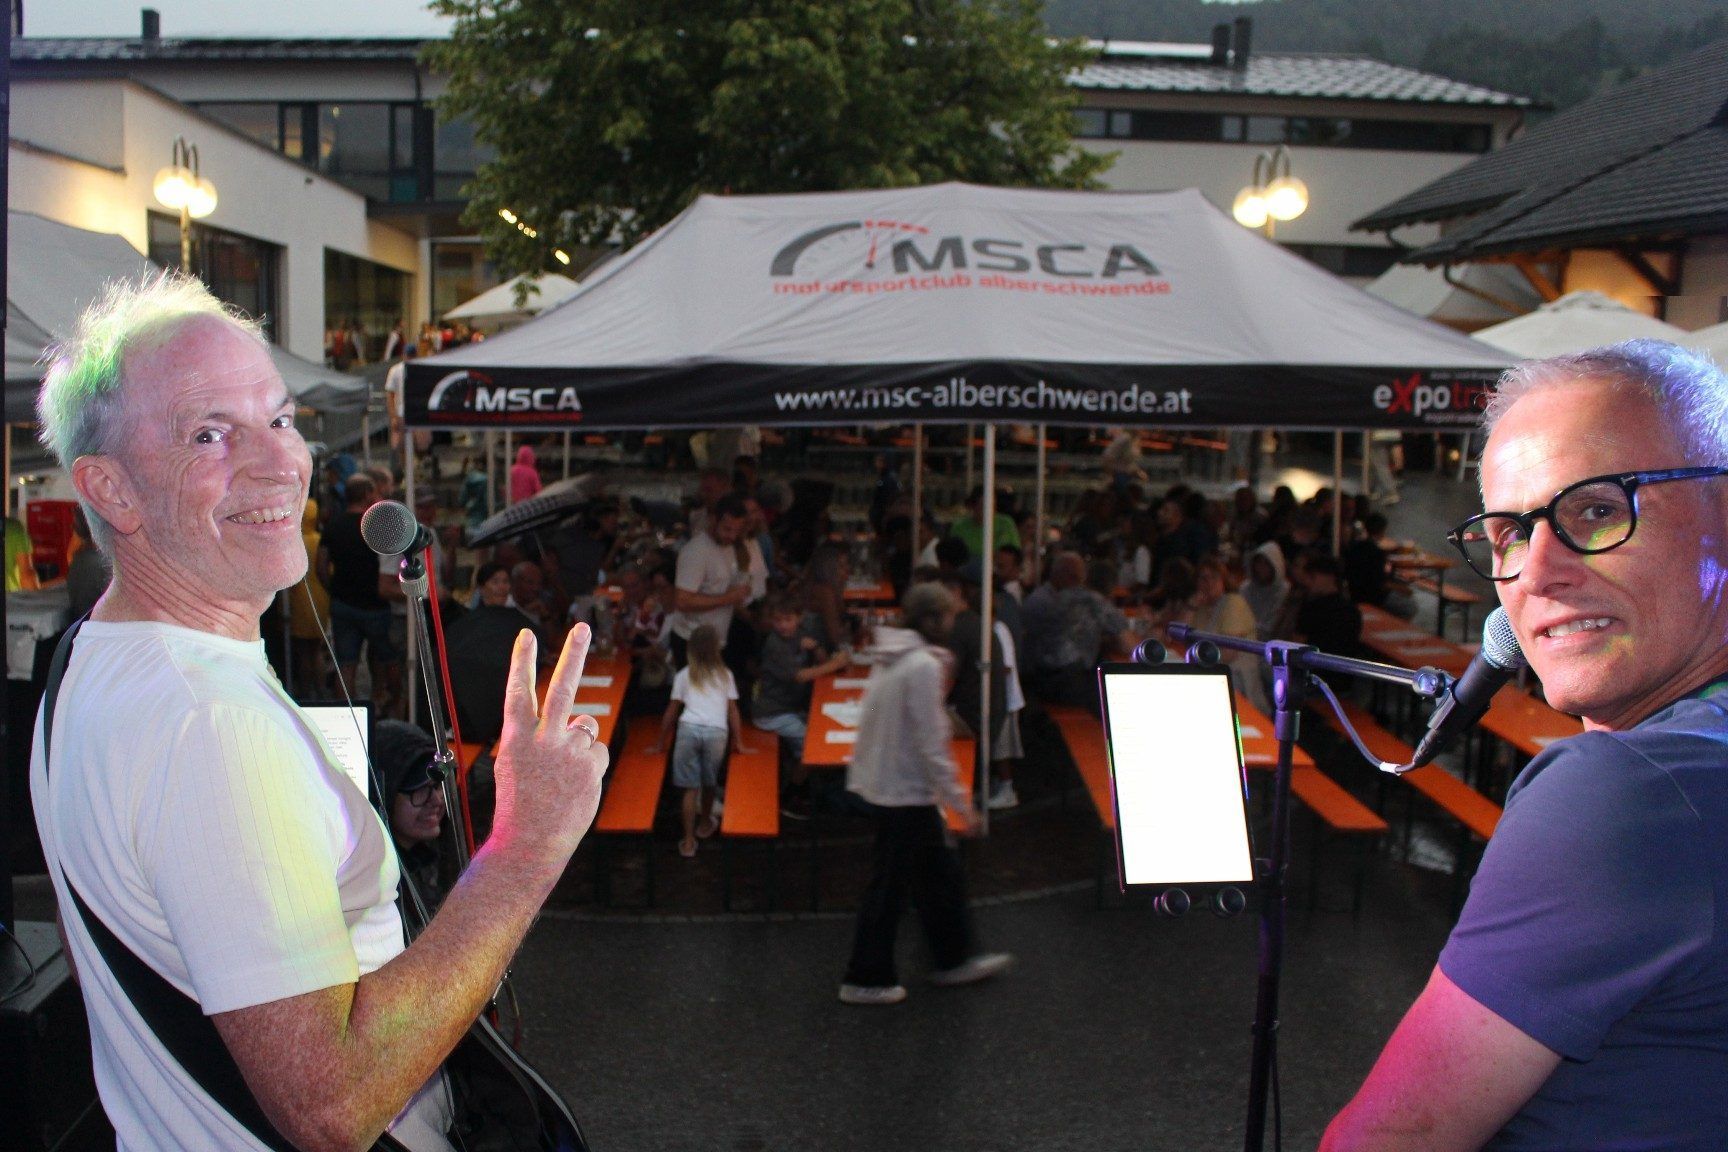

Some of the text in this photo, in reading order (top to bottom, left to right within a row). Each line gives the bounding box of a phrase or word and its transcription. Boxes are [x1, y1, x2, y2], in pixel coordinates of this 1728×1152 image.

[893, 236, 1161, 277] MSCA
[979, 275, 1171, 296] alberschwende
[475, 387, 582, 411] MSCA
[775, 378, 1192, 414] www.msc-alberschwende.at
